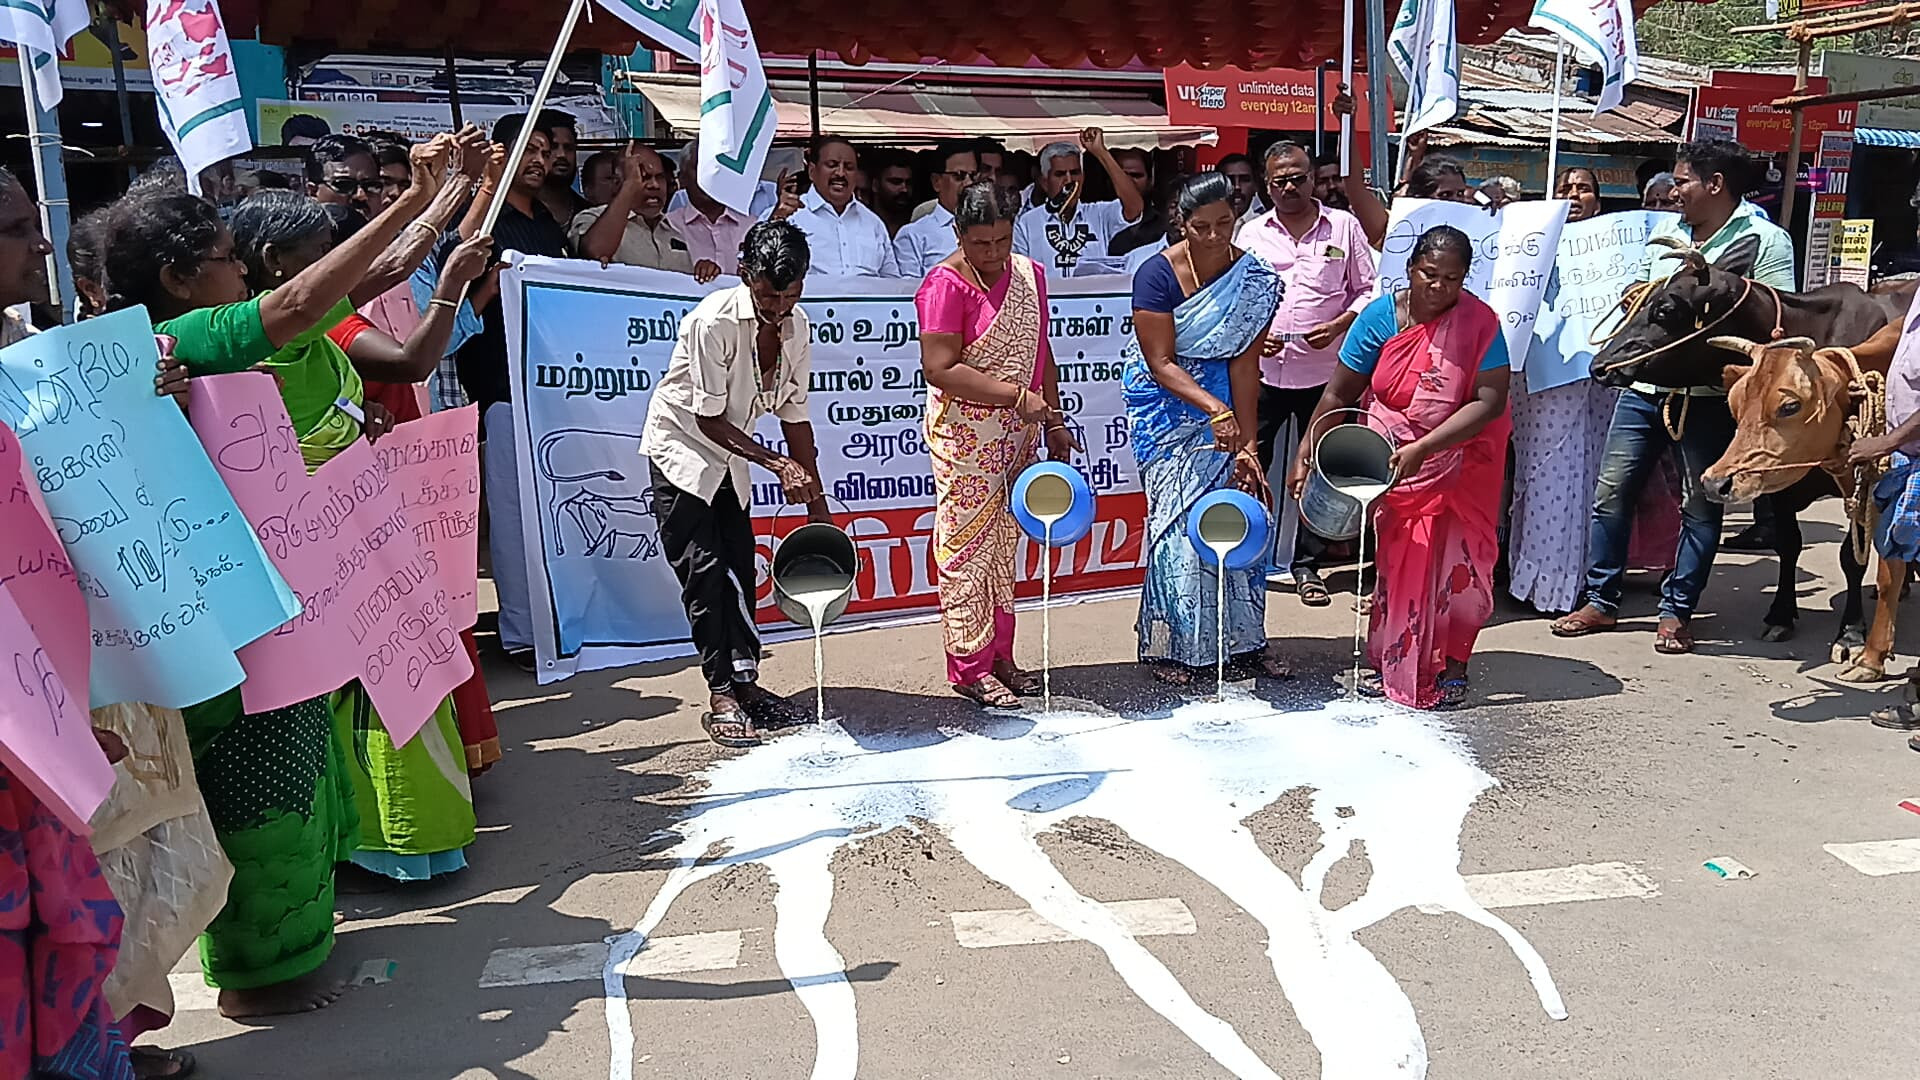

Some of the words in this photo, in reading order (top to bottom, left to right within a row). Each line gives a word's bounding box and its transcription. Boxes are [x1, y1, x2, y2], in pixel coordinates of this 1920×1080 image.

[1239, 81, 1288, 95] unlimited
[1291, 82, 1314, 97] data
[1200, 96, 1225, 108] Hero
[1241, 101, 1288, 115] everyday
[1746, 119, 1780, 129] everyday
[536, 353, 650, 400] மற்றும்
